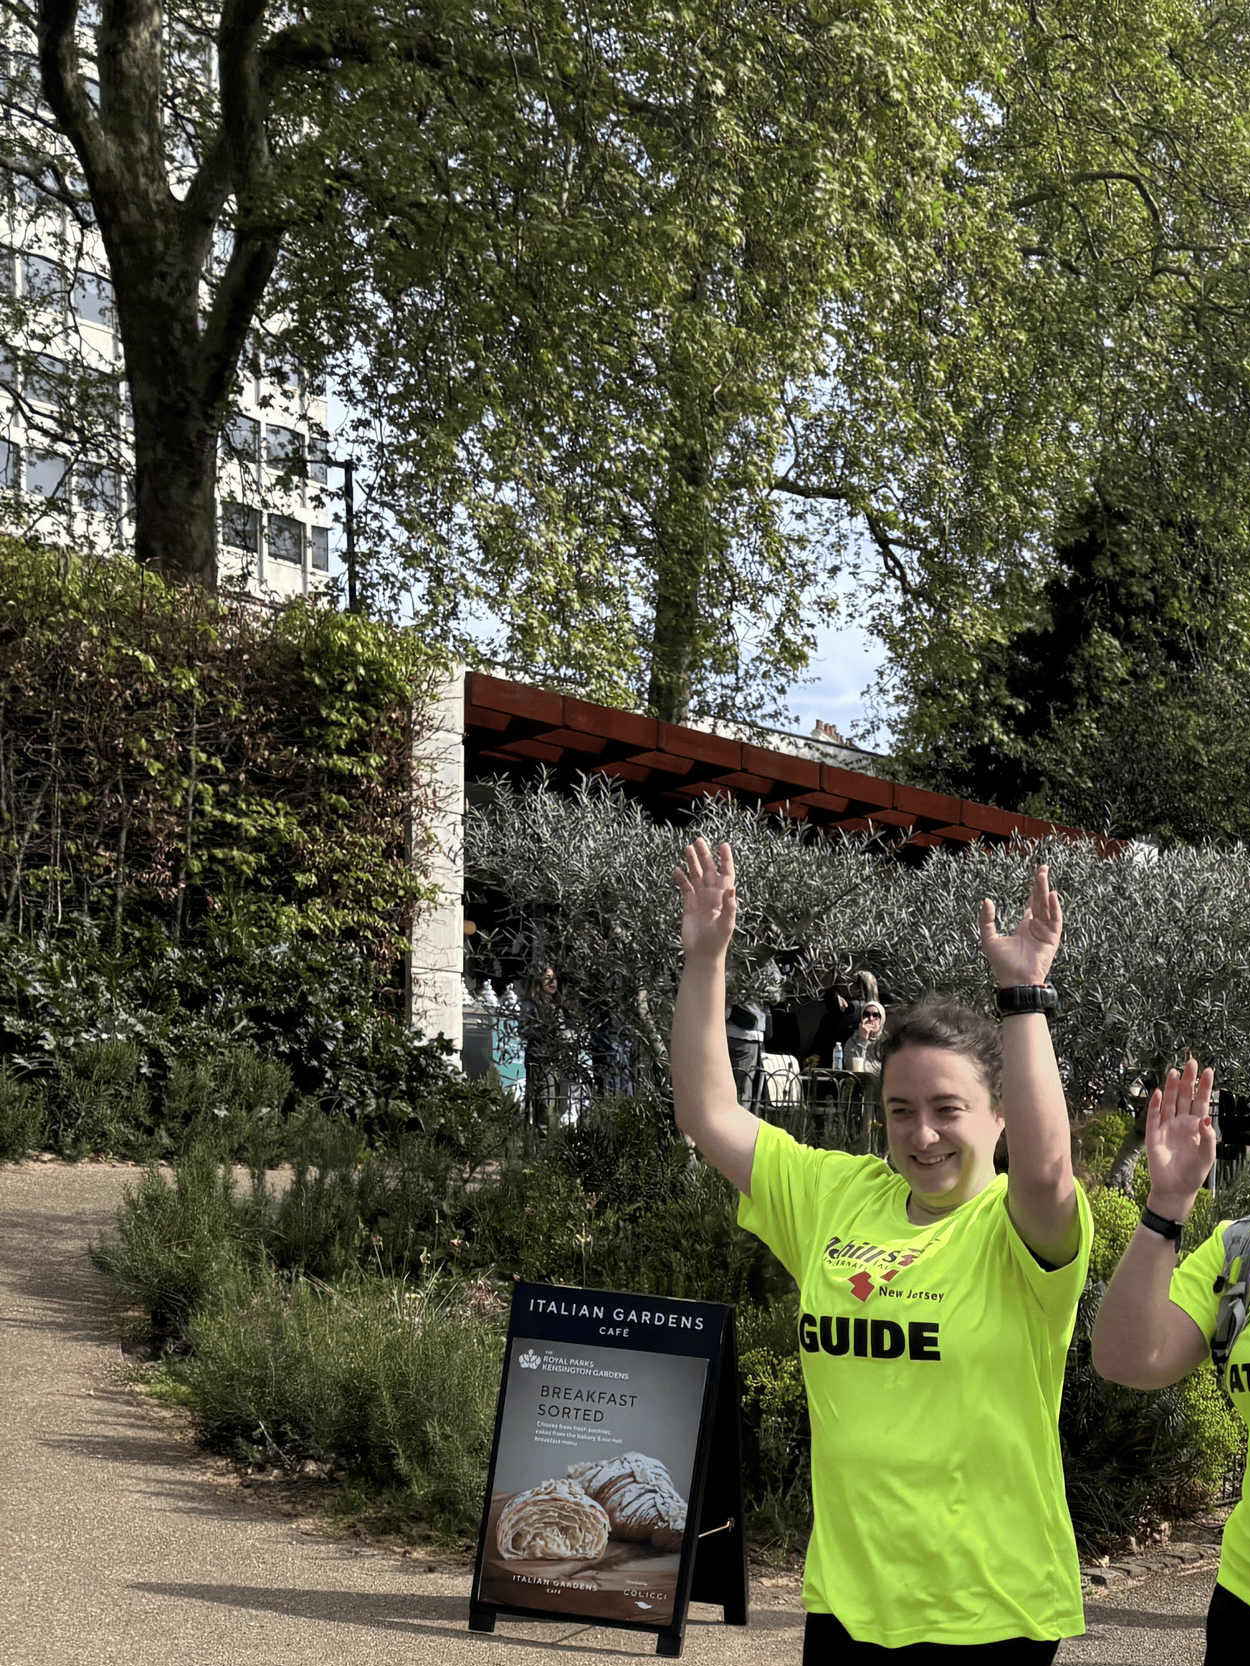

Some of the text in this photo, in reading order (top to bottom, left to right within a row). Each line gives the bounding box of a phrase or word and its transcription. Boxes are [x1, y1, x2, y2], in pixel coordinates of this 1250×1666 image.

[878, 1285, 945, 1303] New Jersey
[529, 1299, 704, 1330] ITALIAN GARDENS
[598, 1326, 630, 1338] CAFÉ
[799, 1312, 942, 1361] GUIDE
[543, 1355, 595, 1368] ROYAL PARKS
[542, 1364, 629, 1380] KENSINGTON GARDENS
[540, 1385, 638, 1408] BREAKFAST
[537, 1403, 604, 1422] SORTED
[512, 1574, 598, 1591] ITALIAN GARDENS
[623, 1588, 668, 1600] COLICCI
